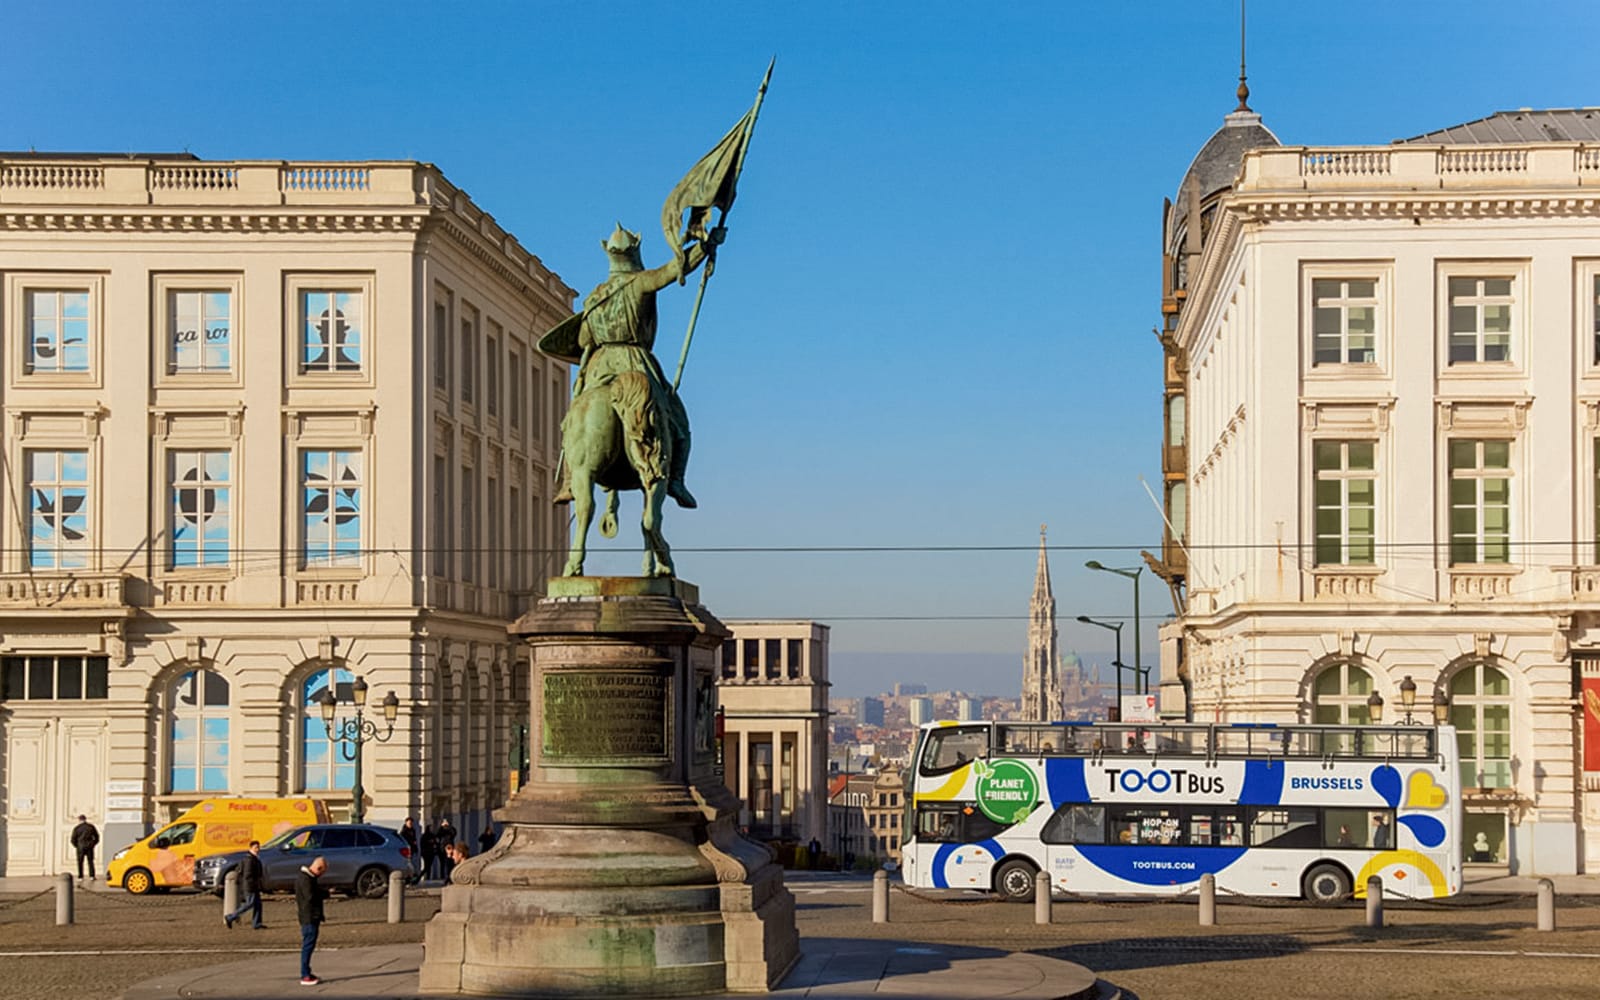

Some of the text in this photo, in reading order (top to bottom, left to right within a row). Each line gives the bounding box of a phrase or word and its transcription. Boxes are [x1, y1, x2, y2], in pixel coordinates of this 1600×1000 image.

[990, 779, 1024, 789] PLANET
[1291, 777, 1363, 790] BRUSSELS
[985, 791, 1029, 801] FRIENDLY
[1142, 818, 1179, 827] HOP-ON
[1140, 830, 1182, 839] HOP-OFF
[1132, 861, 1195, 870] TOOTBUS.COM
